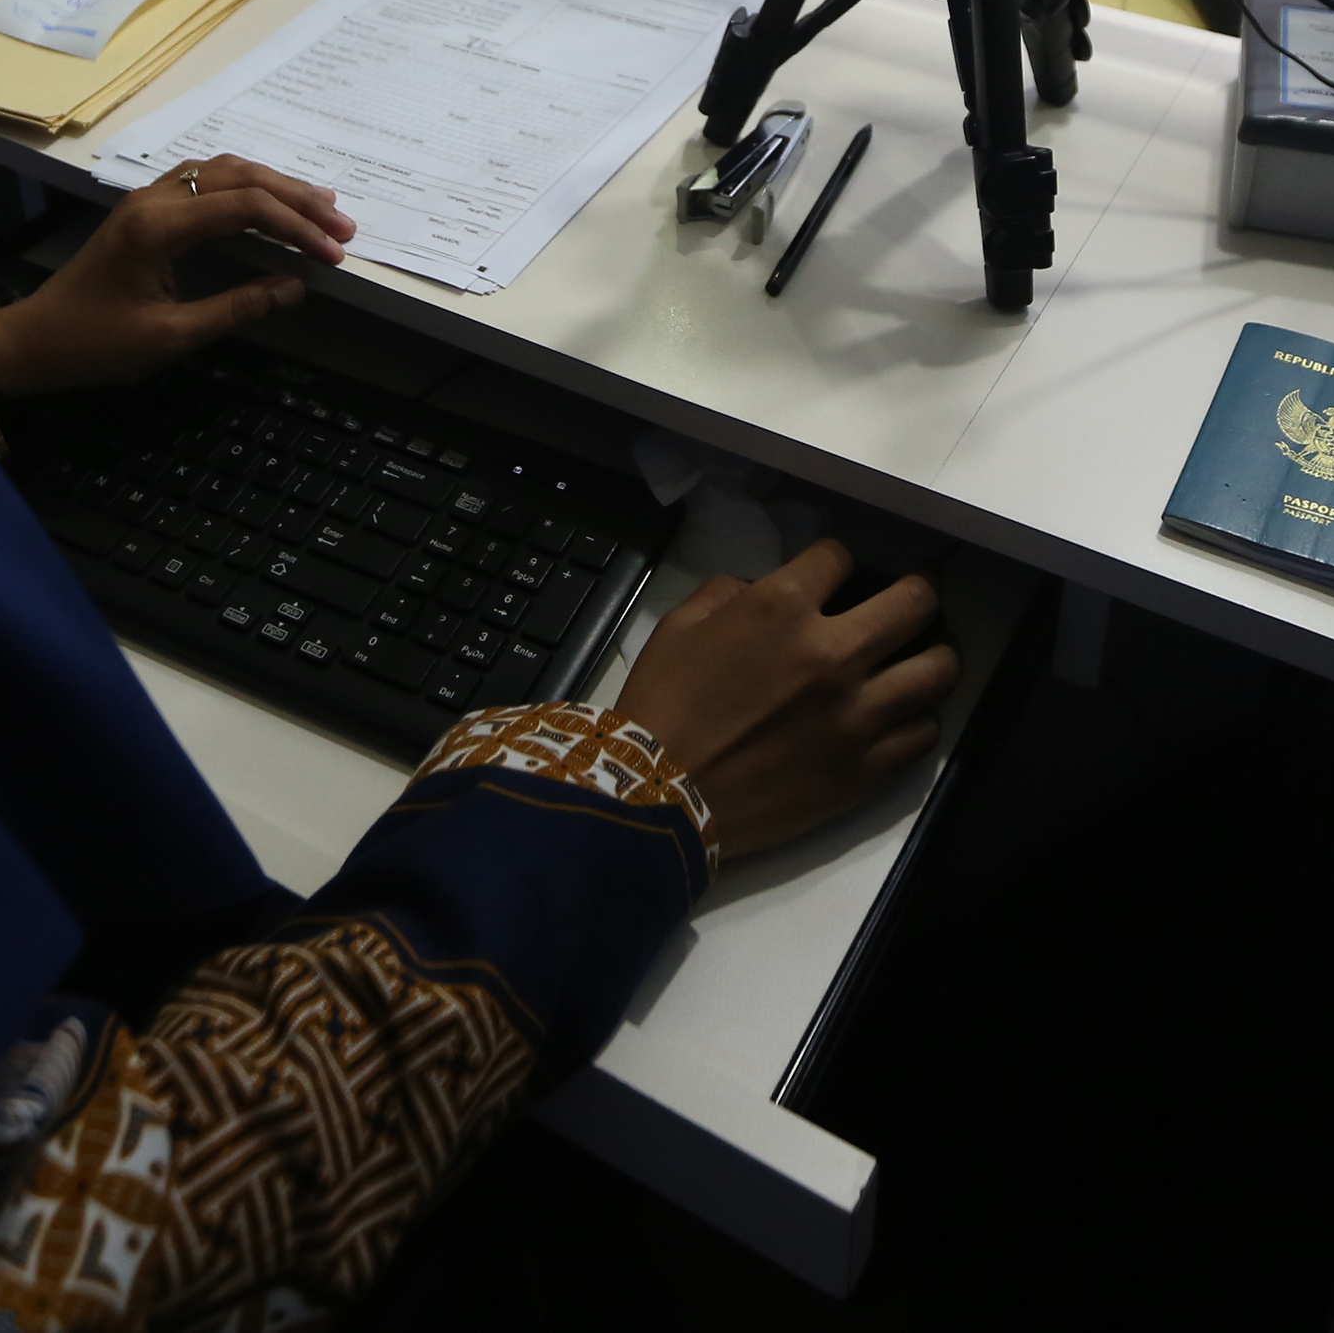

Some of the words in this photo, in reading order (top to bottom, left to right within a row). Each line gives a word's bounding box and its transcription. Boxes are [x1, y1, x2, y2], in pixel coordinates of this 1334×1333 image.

[230, 444, 243, 456] O
[265, 457, 278, 468] P
[175, 464, 190, 477] K
[386, 460, 426, 481] Backspace
[95, 475, 110, 487] N
[210, 479, 221, 491] L
[128, 490, 145, 503] M
[1282, 507, 1334, 528] PASSPORT
[322, 526, 345, 540] Enter
[447, 526, 457, 535] 7
[124, 542, 139, 554] Alt
[429, 538, 454, 554] Home
[487, 542, 498, 553] 8
[278, 550, 298, 564] Shift
[528, 557, 539, 567] 9
[422, 562, 432, 572] 4
[198, 573, 216, 588] Ctrl
[462, 577, 473, 588] 5
[512, 569, 536, 585] PgUp
[503, 593, 514, 605] 6
[379, 612, 399, 625] End
[368, 636, 378, 647] 0
[478, 631, 489, 642] 3
[354, 651, 369, 663] Ins
[513, 644, 538, 660] Enter
[439, 686, 456, 699] Del
